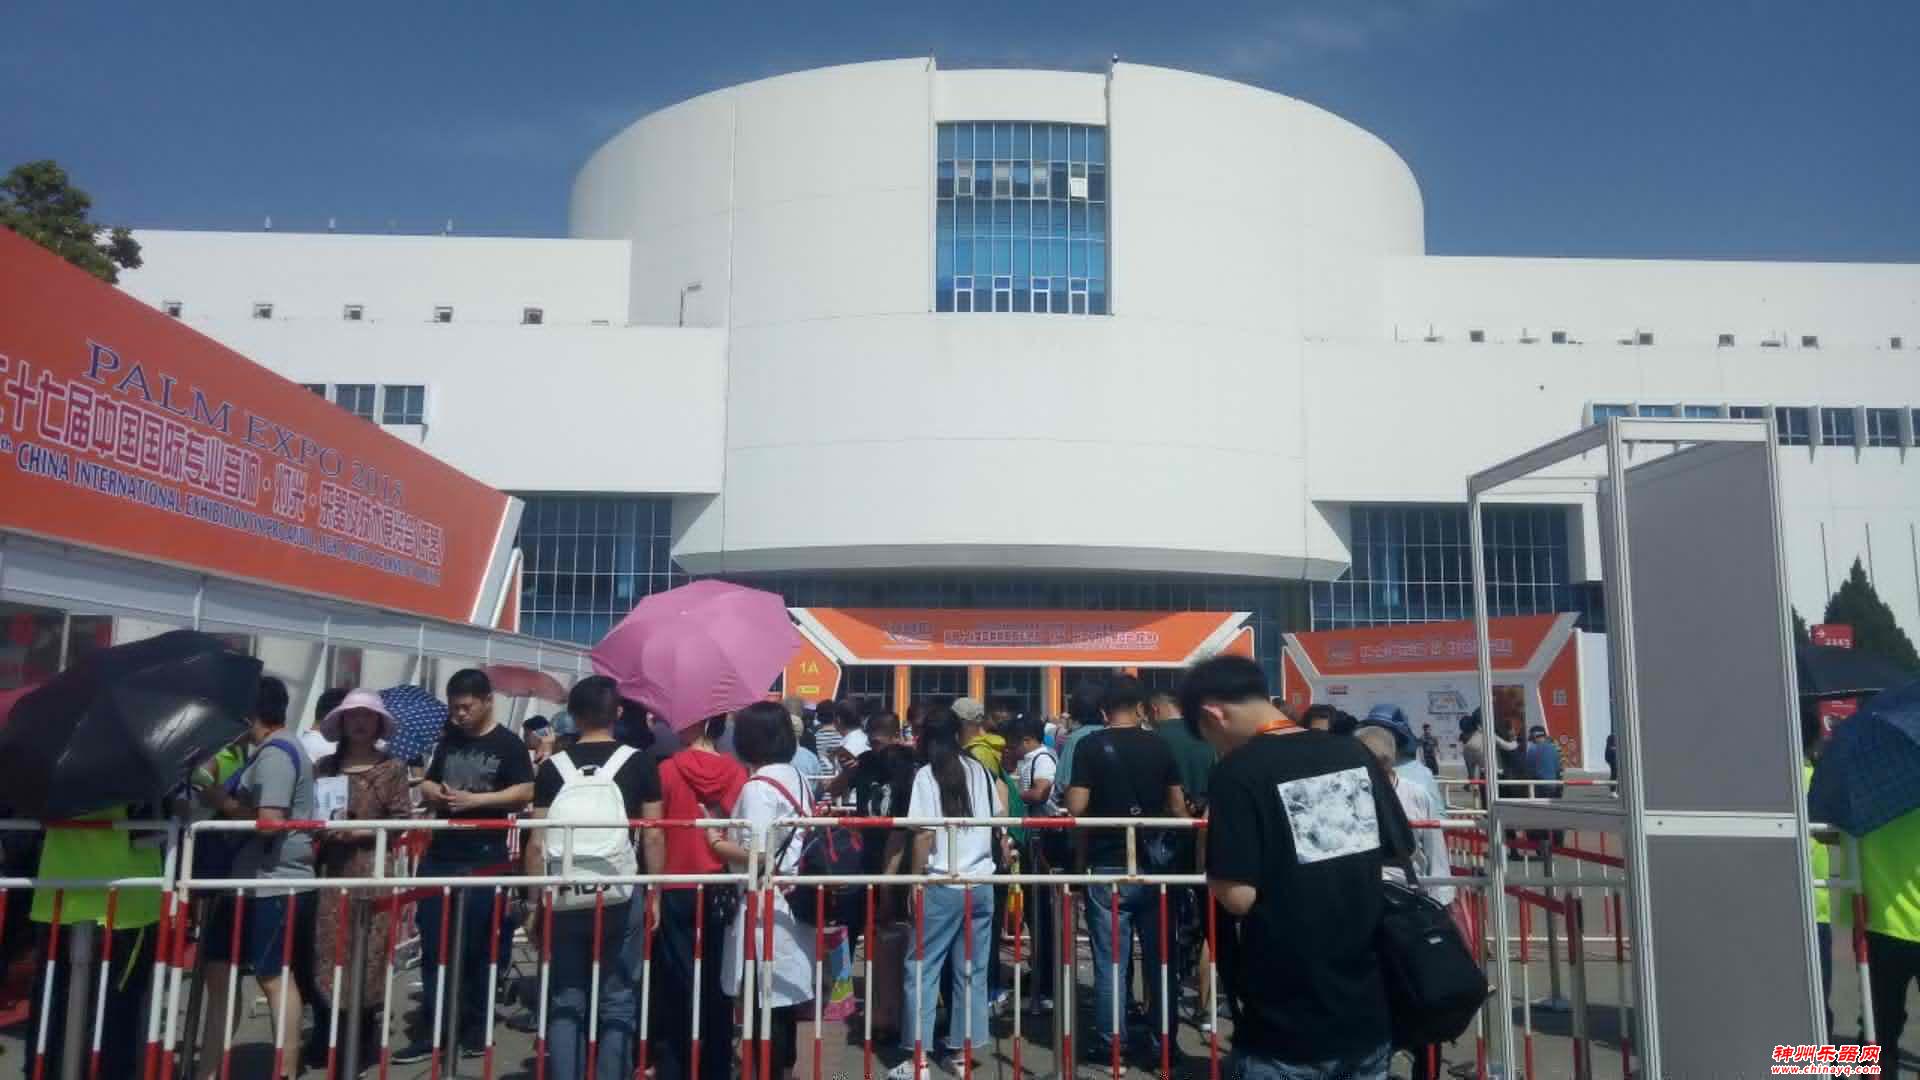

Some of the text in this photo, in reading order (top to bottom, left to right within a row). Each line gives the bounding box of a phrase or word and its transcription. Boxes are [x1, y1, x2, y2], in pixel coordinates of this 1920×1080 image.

[83, 341, 232, 435] PALM
[244, 409, 343, 478] EXPO
[16, 441, 71, 483] CHINA
[74, 460, 181, 514] INTERNATIONAL
[800, 660, 821, 674] 1A
